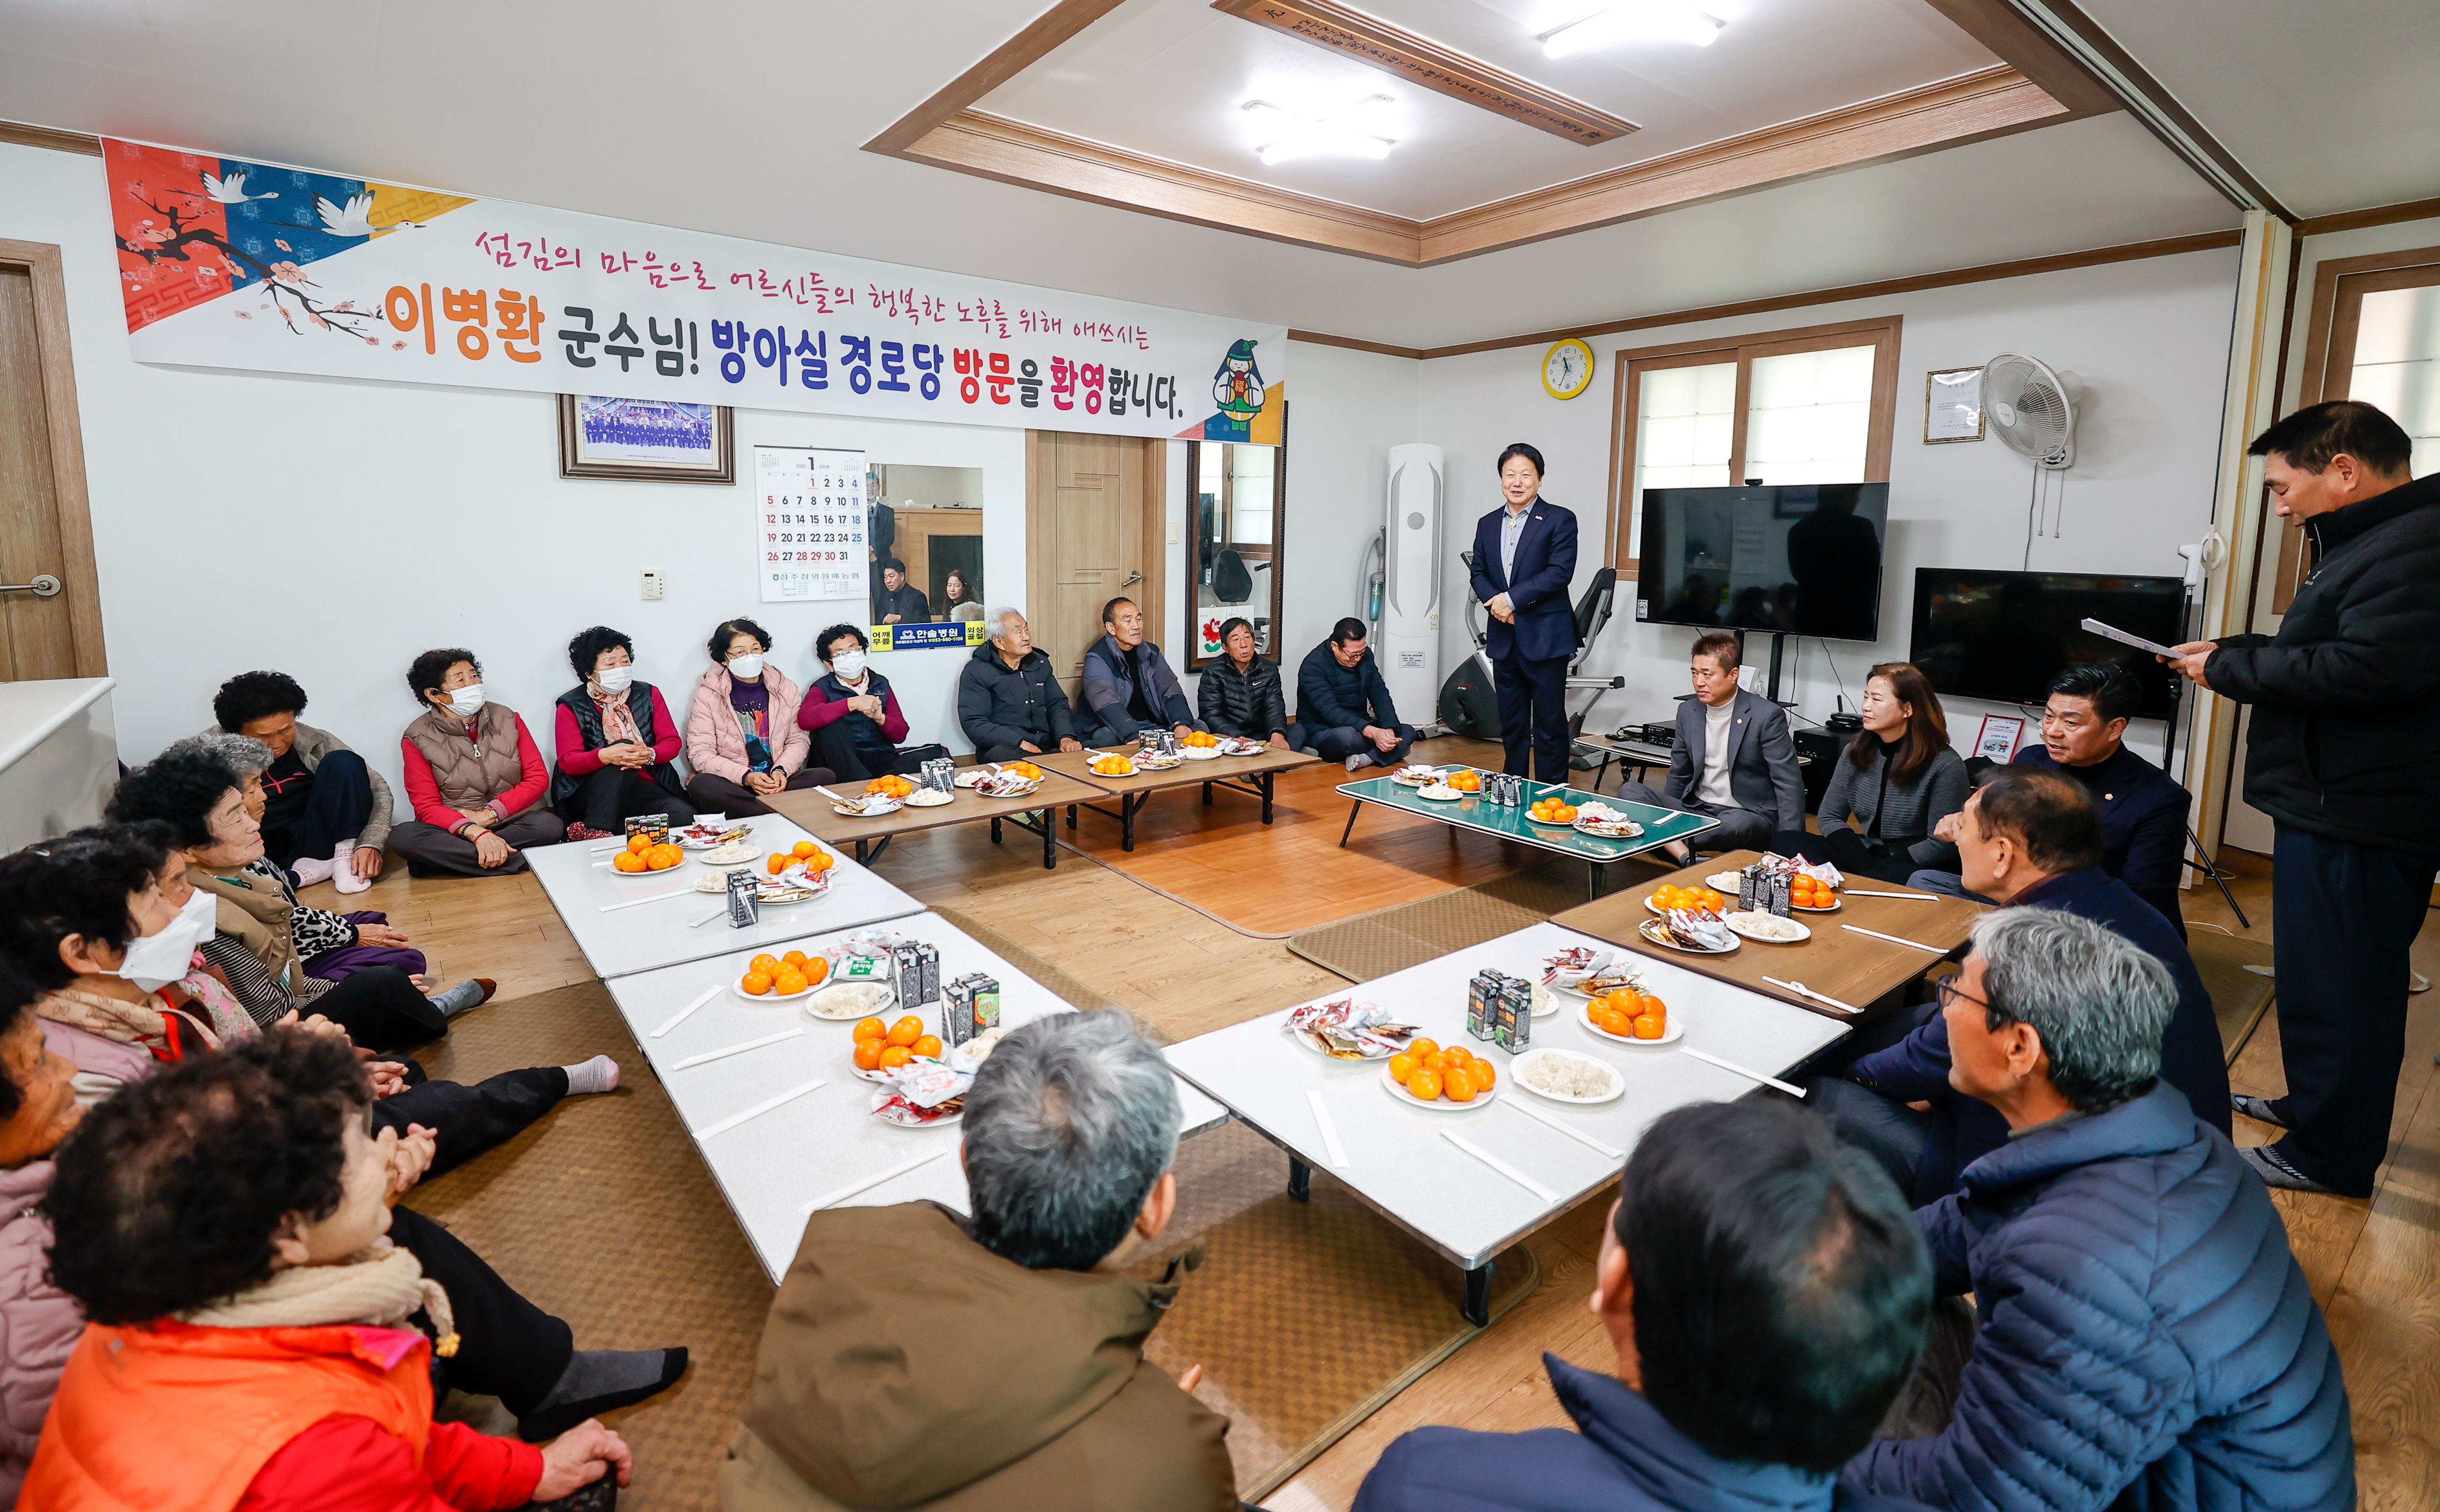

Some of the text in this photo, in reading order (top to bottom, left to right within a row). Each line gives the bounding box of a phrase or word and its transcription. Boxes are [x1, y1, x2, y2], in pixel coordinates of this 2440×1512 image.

[476, 232, 1149, 349] 섬김의 마음으로 어르신들의 행복한 노후를 위해 애쓰시는
[385, 283, 1183, 418] 이병환 군수님! 방아실 경로당 방문을 환영합니다.
[808, 457, 814, 470] 1
[811, 478, 858, 488] 1 2 3 4
[768, 496, 858, 506] 5 6 7 8 9 10 11
[766, 514, 860, 524] 12 13 14 15 16 17 18
[767, 533, 862, 542] 19 20 21 22 23 24 25
[767, 551, 848, 561] 26 27 28 29 30 31
[916, 628, 958, 638] 한솔병원
